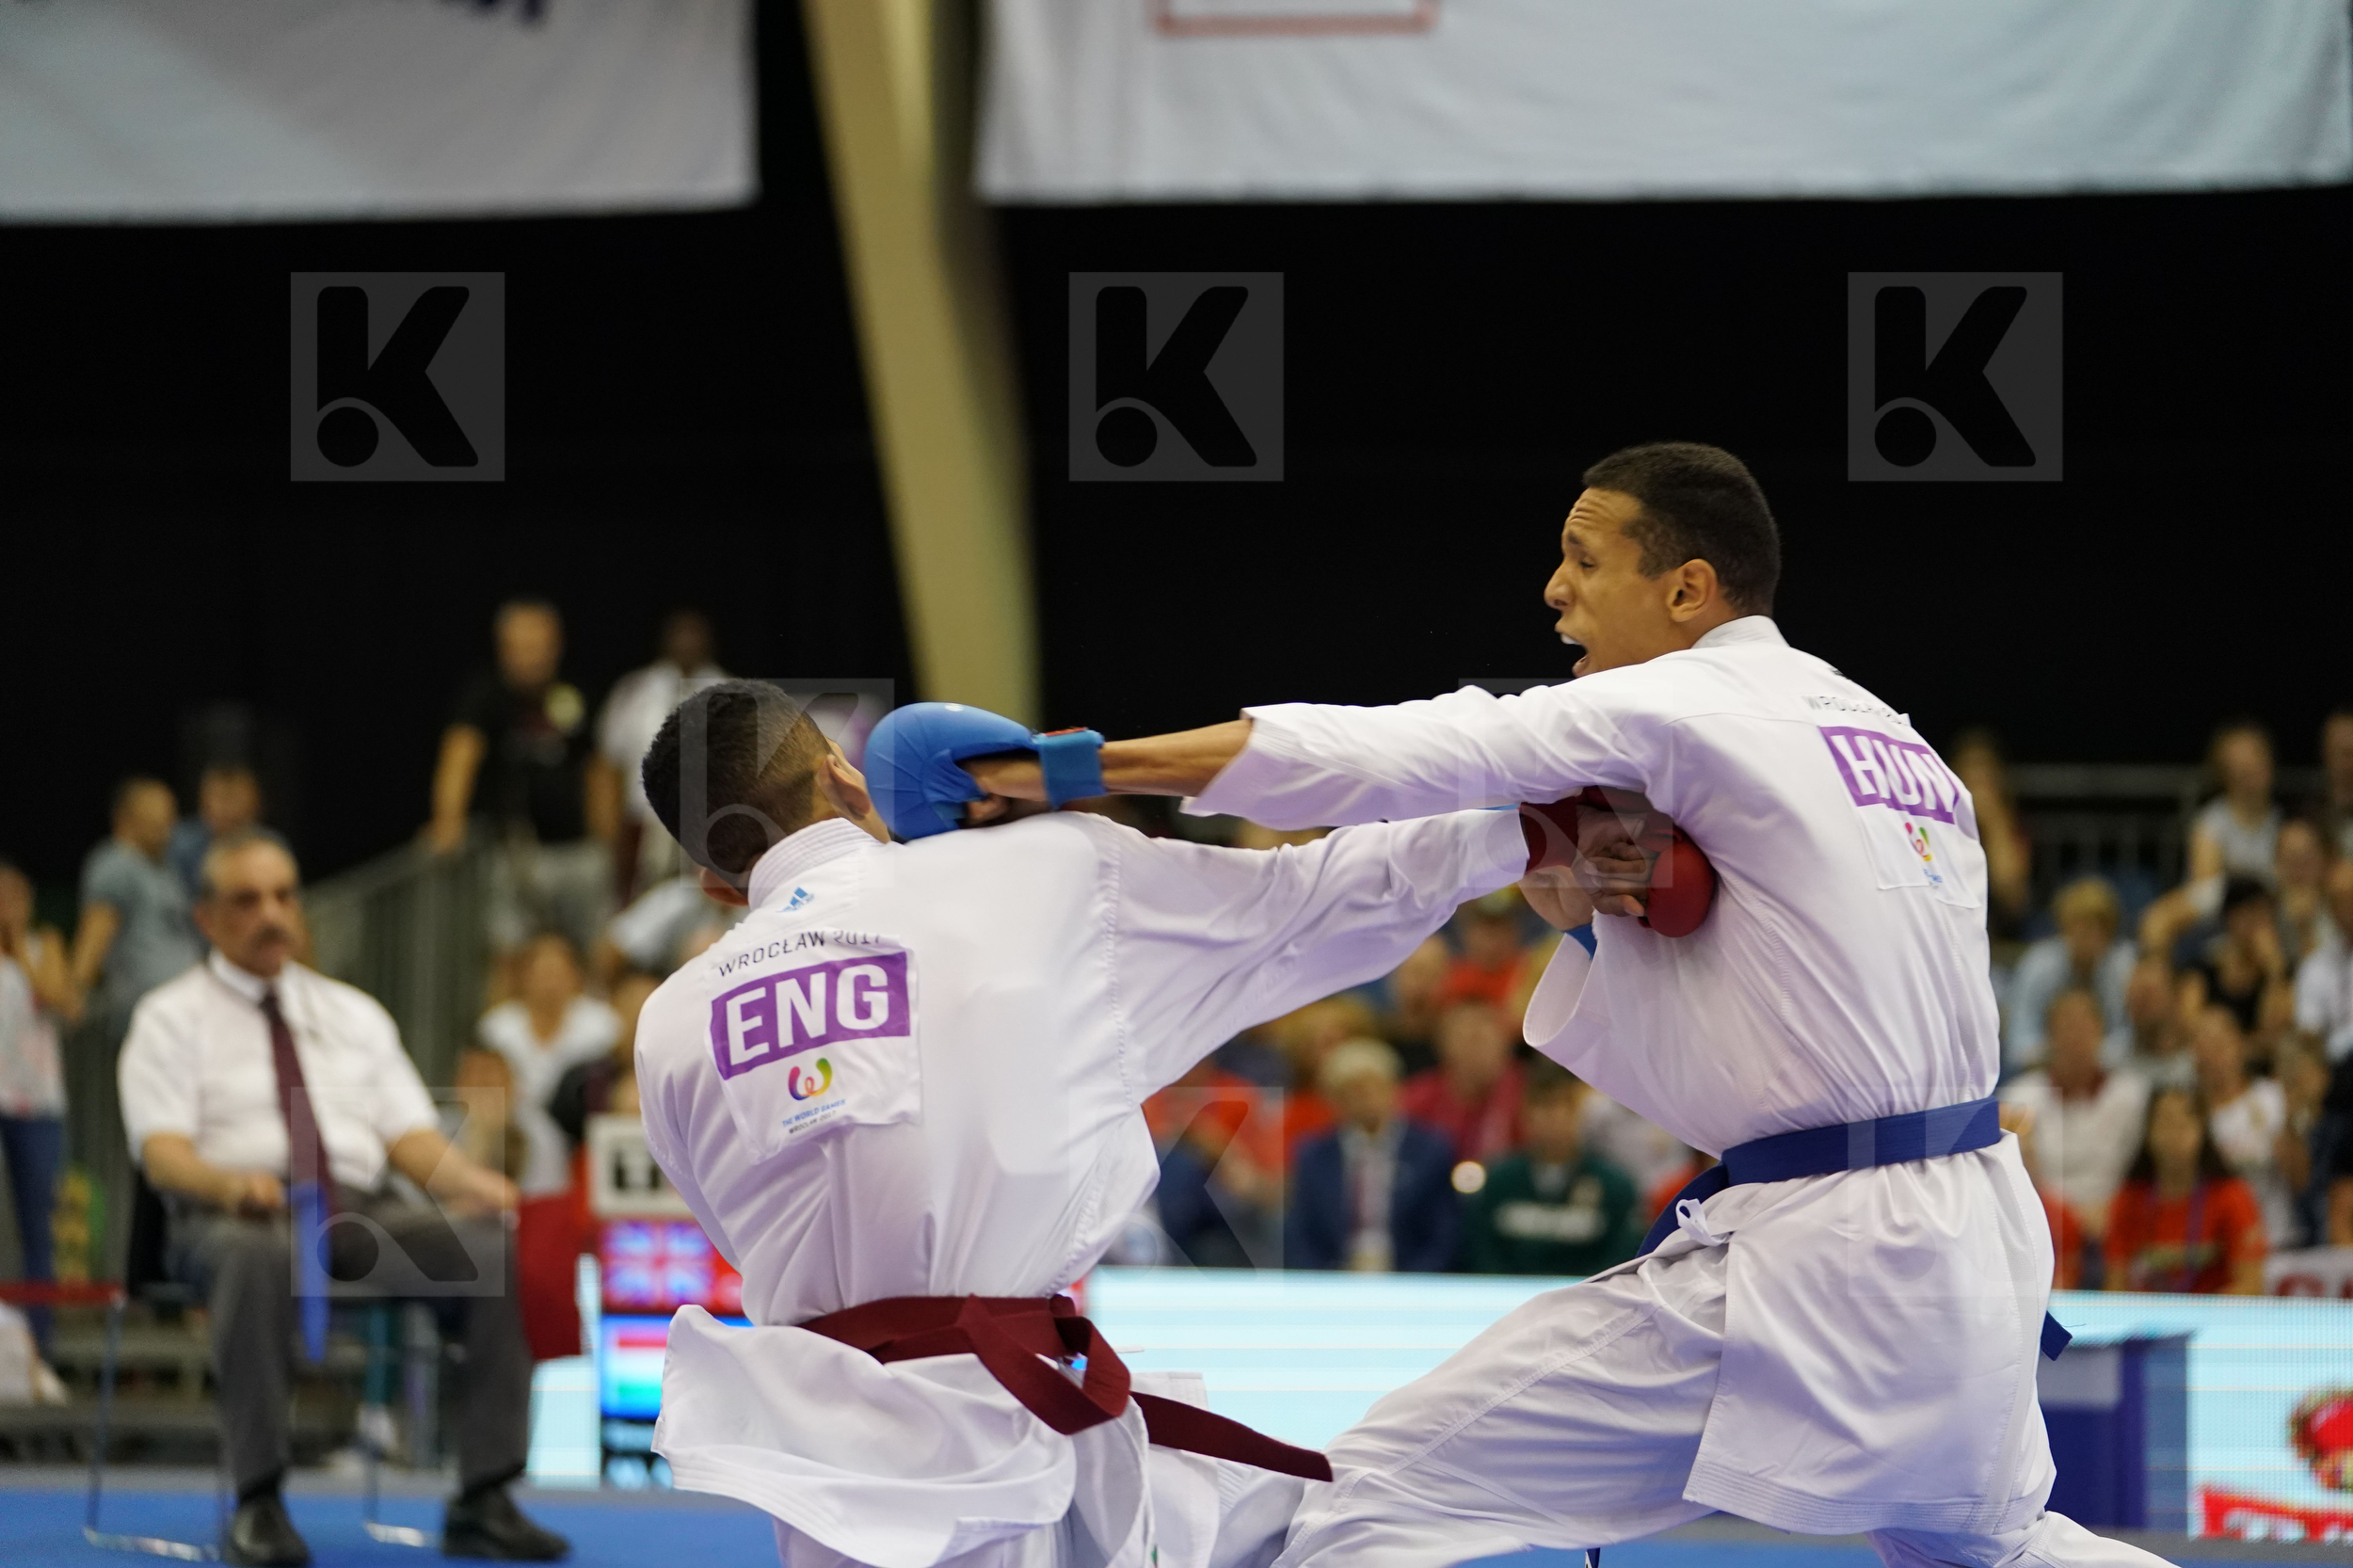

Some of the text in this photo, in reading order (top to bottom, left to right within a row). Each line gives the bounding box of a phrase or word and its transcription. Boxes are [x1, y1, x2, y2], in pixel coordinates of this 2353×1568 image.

[1830, 735, 1953, 813] HUN
[719, 931, 824, 977] WROCŁAW
[726, 964, 888, 1066] ENG
